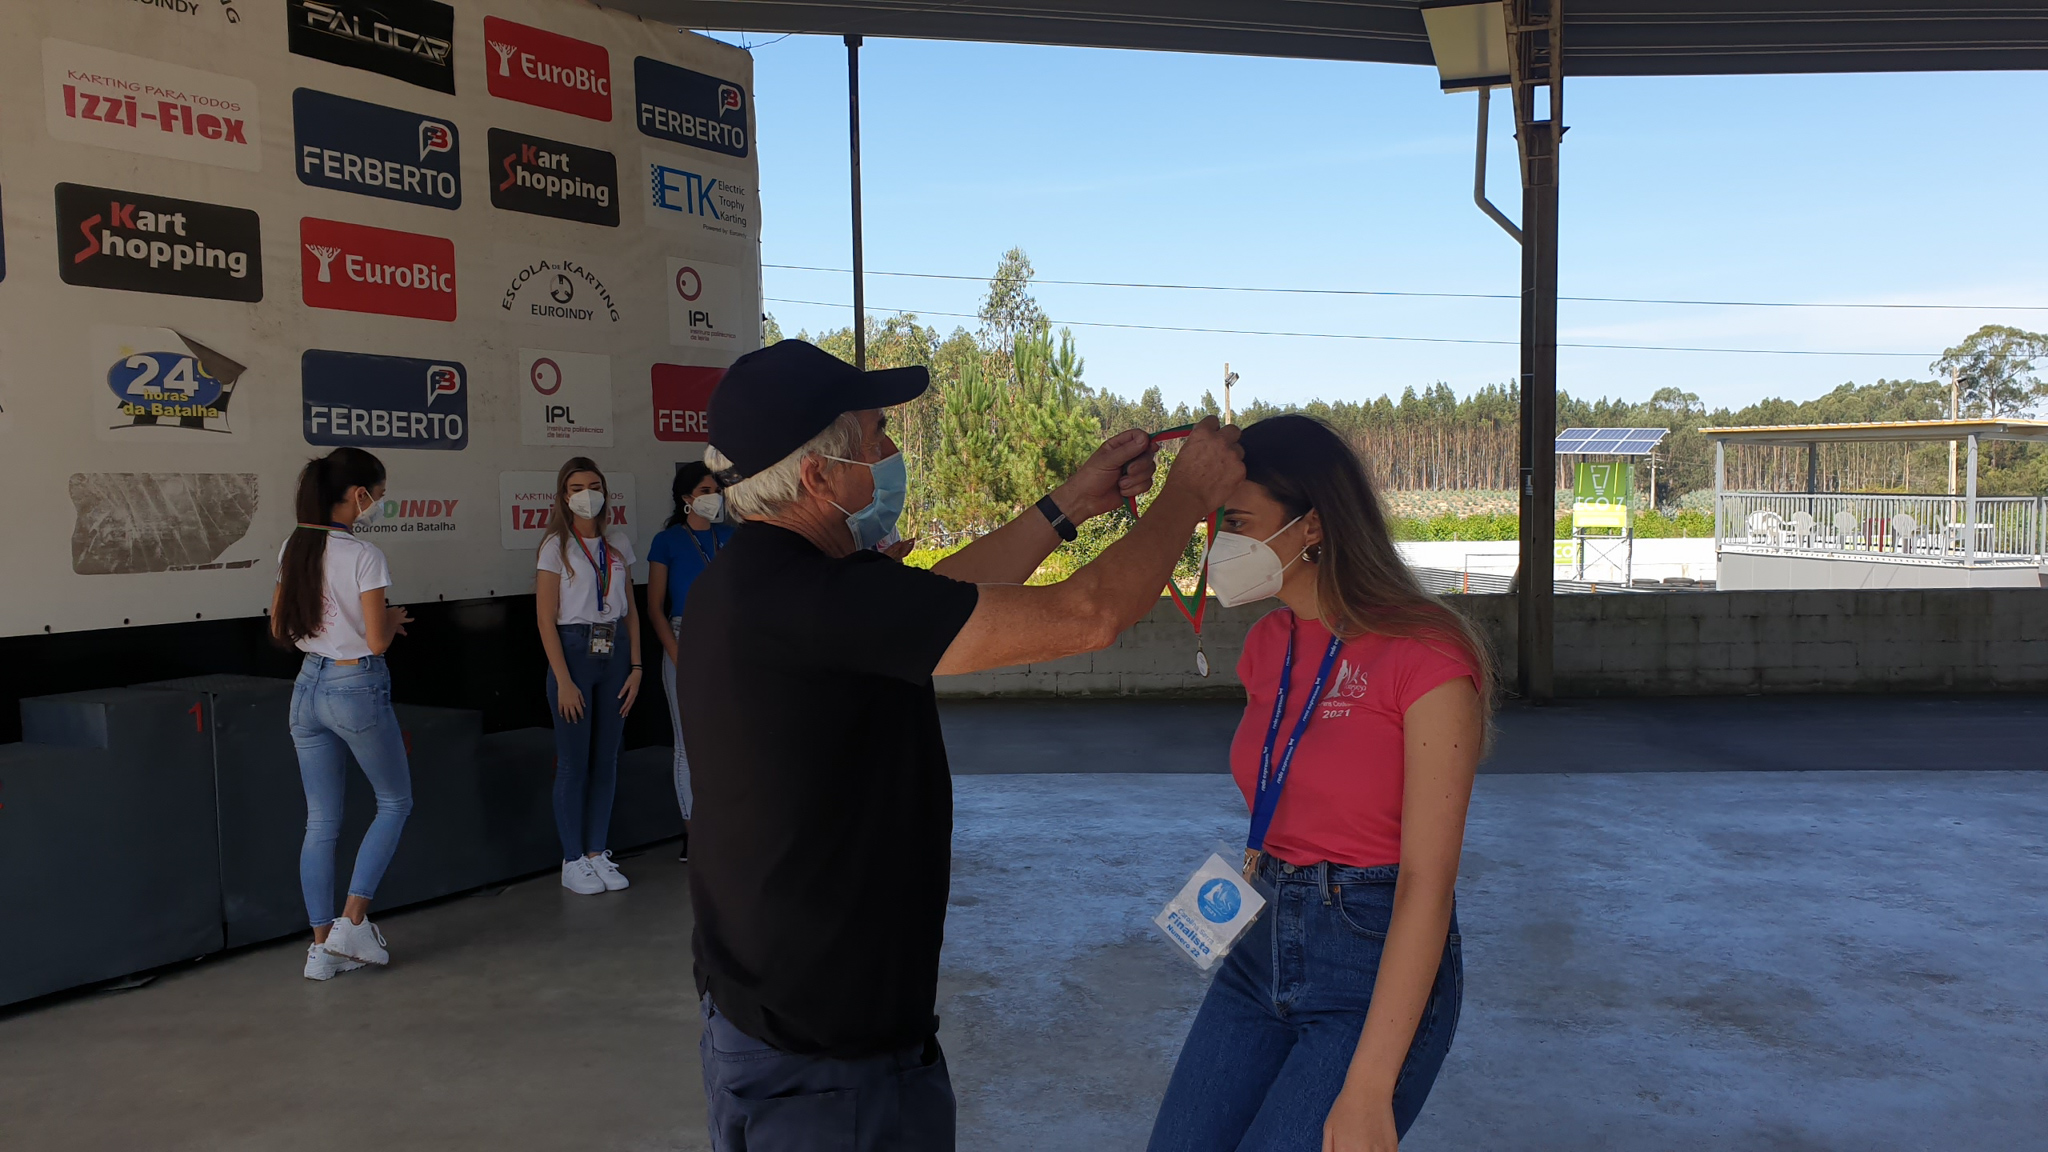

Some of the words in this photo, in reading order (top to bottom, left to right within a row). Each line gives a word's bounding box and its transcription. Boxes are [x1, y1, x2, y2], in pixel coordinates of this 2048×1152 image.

[67, 70, 141, 92] KARTING
[145, 85, 187, 101] PARA
[190, 95, 241, 112] TODOS
[520, 53, 609, 96] EuroBic
[62, 84, 248, 145] Izzi-Flex
[641, 102, 744, 149] FERBERTO
[303, 145, 456, 199] FERBERTO
[521, 143, 570, 173] Kart
[500, 153, 609, 207] Shopping
[654, 164, 721, 220] ETK
[718, 180, 746, 196] Electric
[111, 201, 187, 237] Kart
[718, 195, 745, 213] Trophy
[720, 211, 747, 228] Karting
[74, 213, 248, 279] Shopping
[345, 254, 452, 293] EuroBic
[502, 260, 550, 311] ESCOLA
[563, 260, 620, 322] KARTING
[531, 303, 594, 321] EUROINDY
[688, 309, 713, 329] IPL
[126, 354, 199, 397] 24
[122, 402, 146, 416] da
[151, 403, 219, 418] Batalha
[143, 387, 189, 402] horas
[311, 406, 463, 440] FERBERTO
[545, 405, 575, 425] IPL
[1575, 496, 1610, 511] ECO
[1615, 496, 1624, 511] 7
[400, 523, 414, 532] da
[417, 522, 456, 532] Batalha
[188, 702, 203, 732] 1
[1322, 708, 1351, 719] 2021
[1166, 923, 1190, 949] Numero
[1190, 947, 1200, 958] 22
[1168, 911, 1210, 955] Finalista
